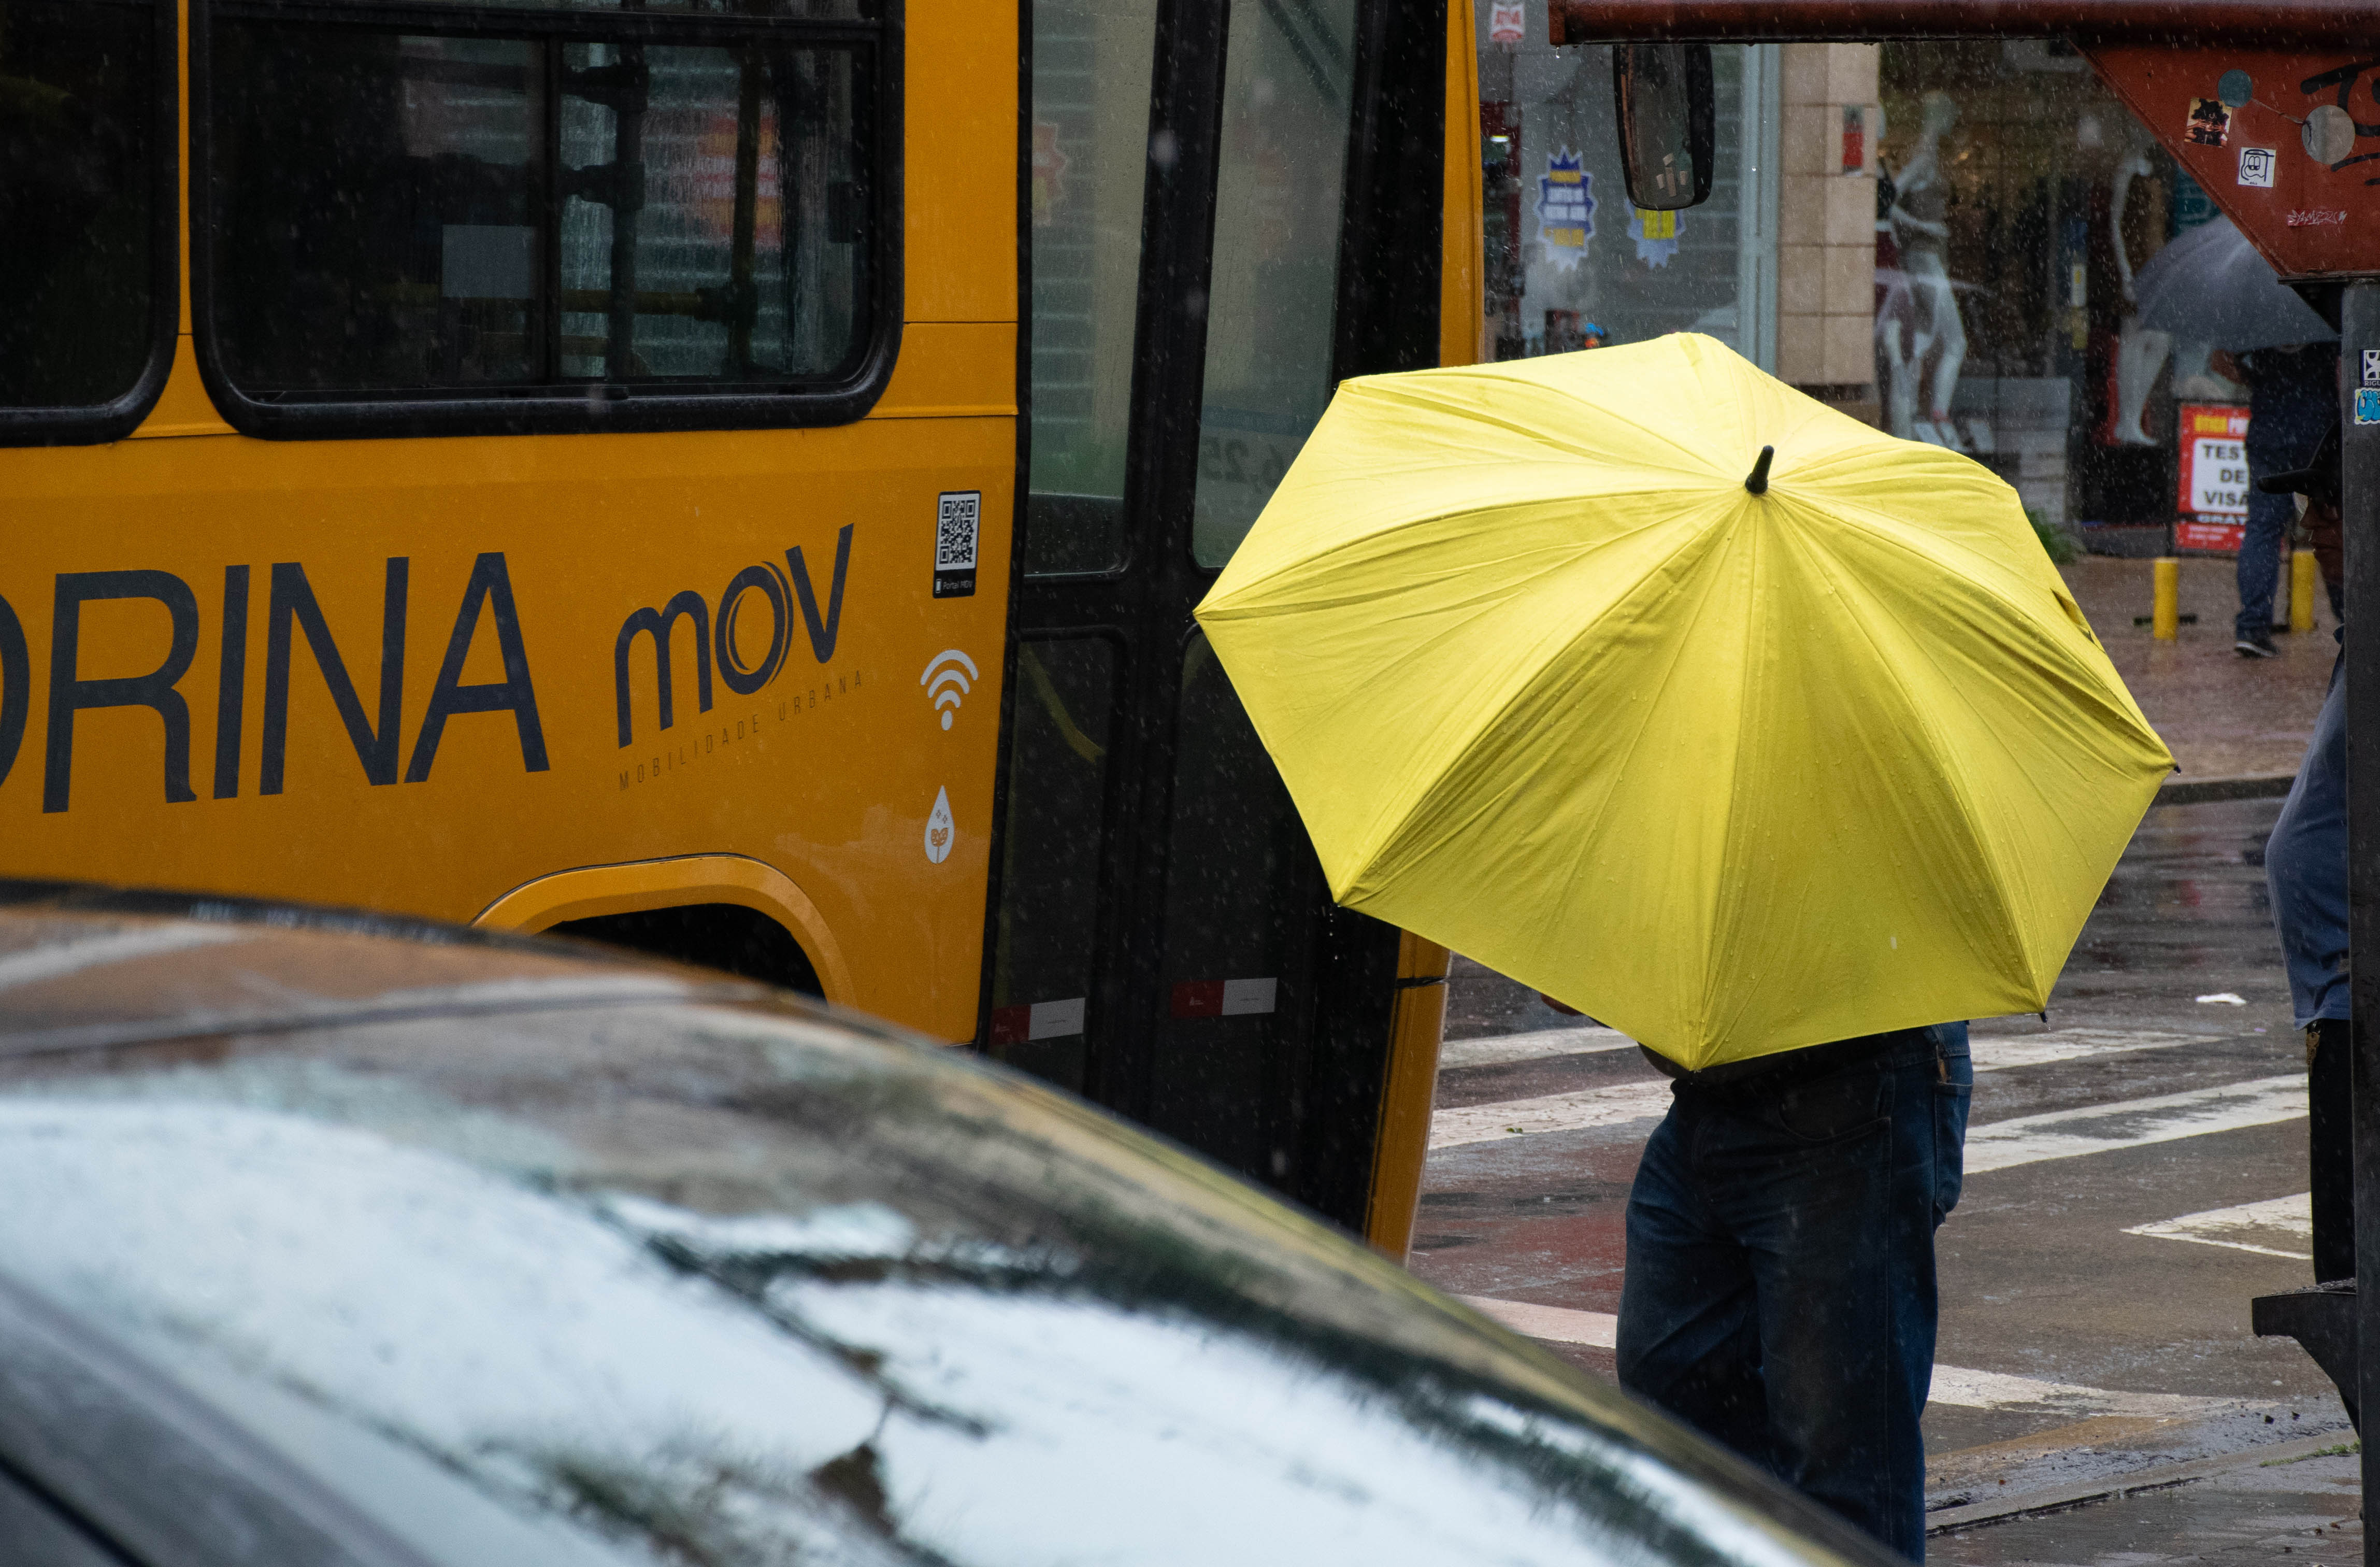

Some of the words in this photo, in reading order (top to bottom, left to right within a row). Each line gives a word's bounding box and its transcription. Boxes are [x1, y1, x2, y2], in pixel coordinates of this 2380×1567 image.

[2220, 468, 2245, 483] DE
[0, 552, 550, 814] RINA
[619, 714, 759, 791] MOBILIDADE
[779, 671, 862, 722] URBANA
